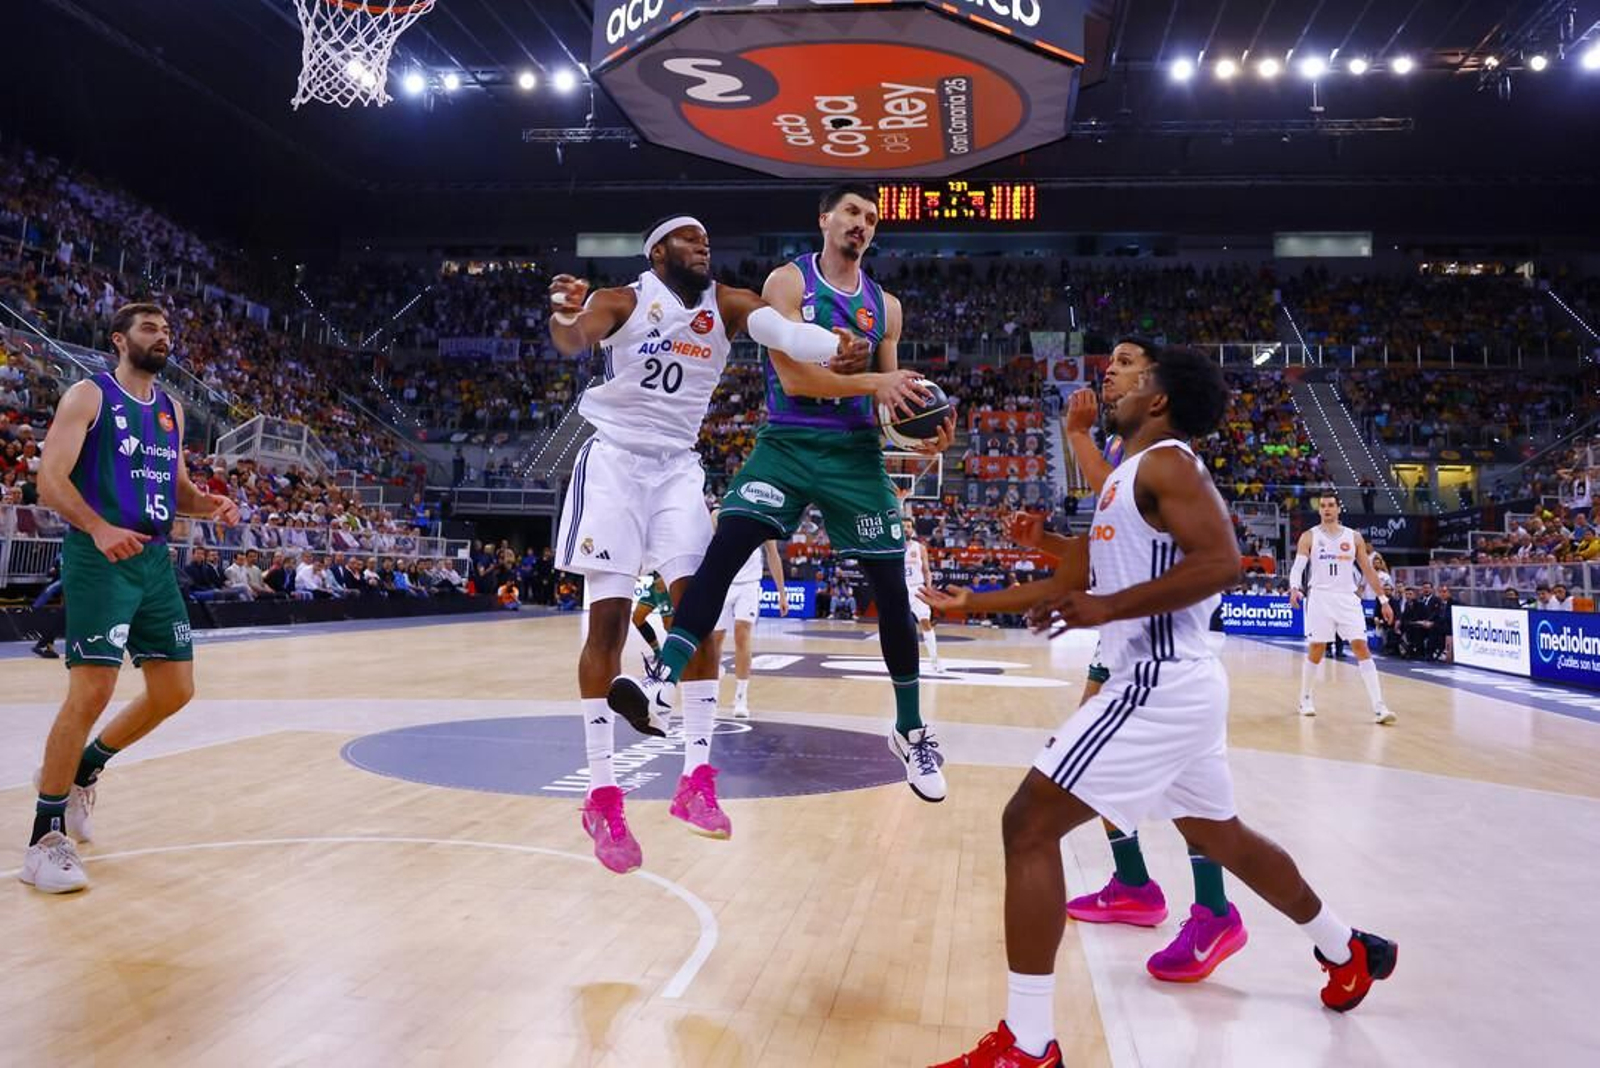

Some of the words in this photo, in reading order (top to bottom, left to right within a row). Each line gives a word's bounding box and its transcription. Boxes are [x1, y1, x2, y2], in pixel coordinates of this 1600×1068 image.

[878, 82, 936, 130] Rey
[943, 95, 968, 134] Canaria
[772, 113, 815, 146] acb
[949, 134, 969, 155] Gran
[640, 358, 683, 394] 20
[145, 493, 169, 521] 45
[1329, 563, 1338, 576] 11
[1460, 618, 1521, 646] mediolanum
